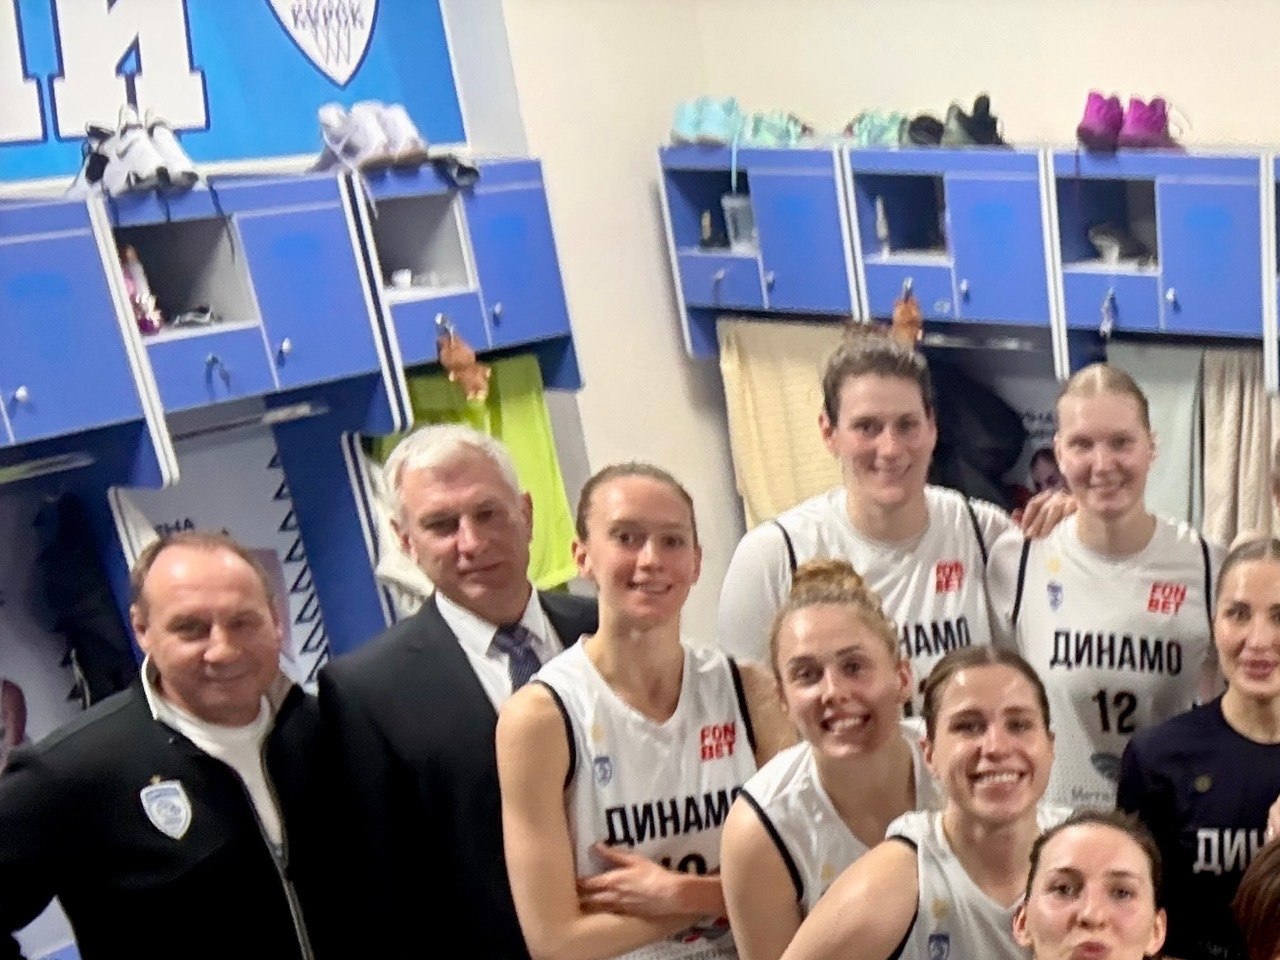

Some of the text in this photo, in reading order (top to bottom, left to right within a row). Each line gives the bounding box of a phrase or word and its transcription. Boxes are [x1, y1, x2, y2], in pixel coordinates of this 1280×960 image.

[1049, 629, 1183, 677] ДИНАМО
[700, 721, 736, 745] FON
[1091, 687, 1138, 735] 12
